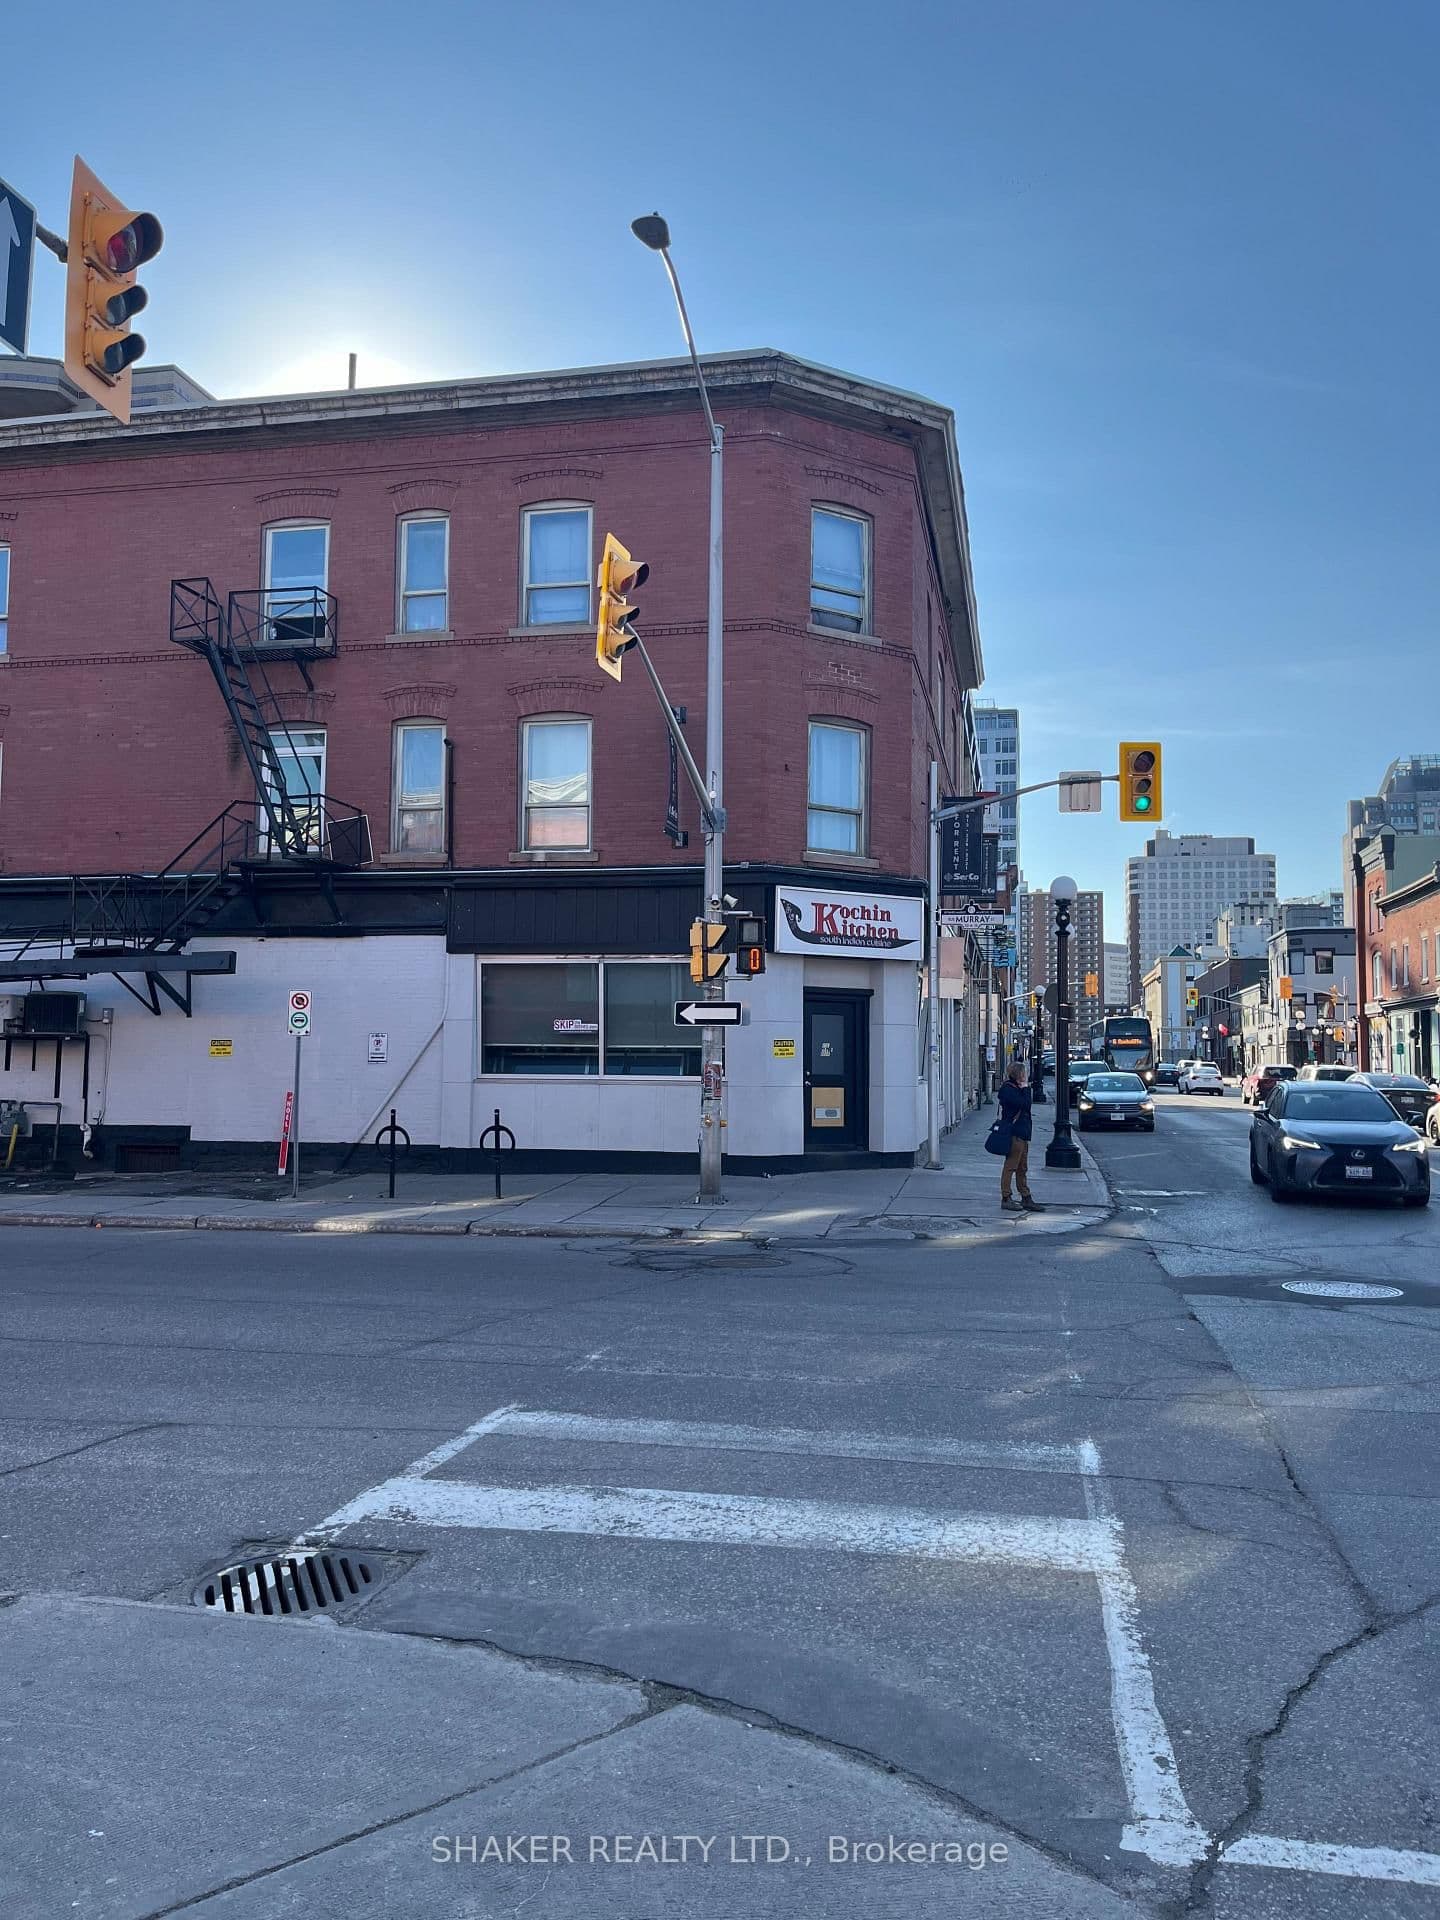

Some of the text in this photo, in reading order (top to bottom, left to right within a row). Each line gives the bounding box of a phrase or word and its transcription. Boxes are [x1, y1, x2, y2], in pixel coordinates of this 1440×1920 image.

[952, 840, 960, 870] RENT
[953, 872, 980, 881] SerCo
[811, 902, 893, 937] Kochin
[955, 915, 990, 923] MURRAY
[819, 935, 842, 945] south
[554, 1020, 574, 1030] SKIP
